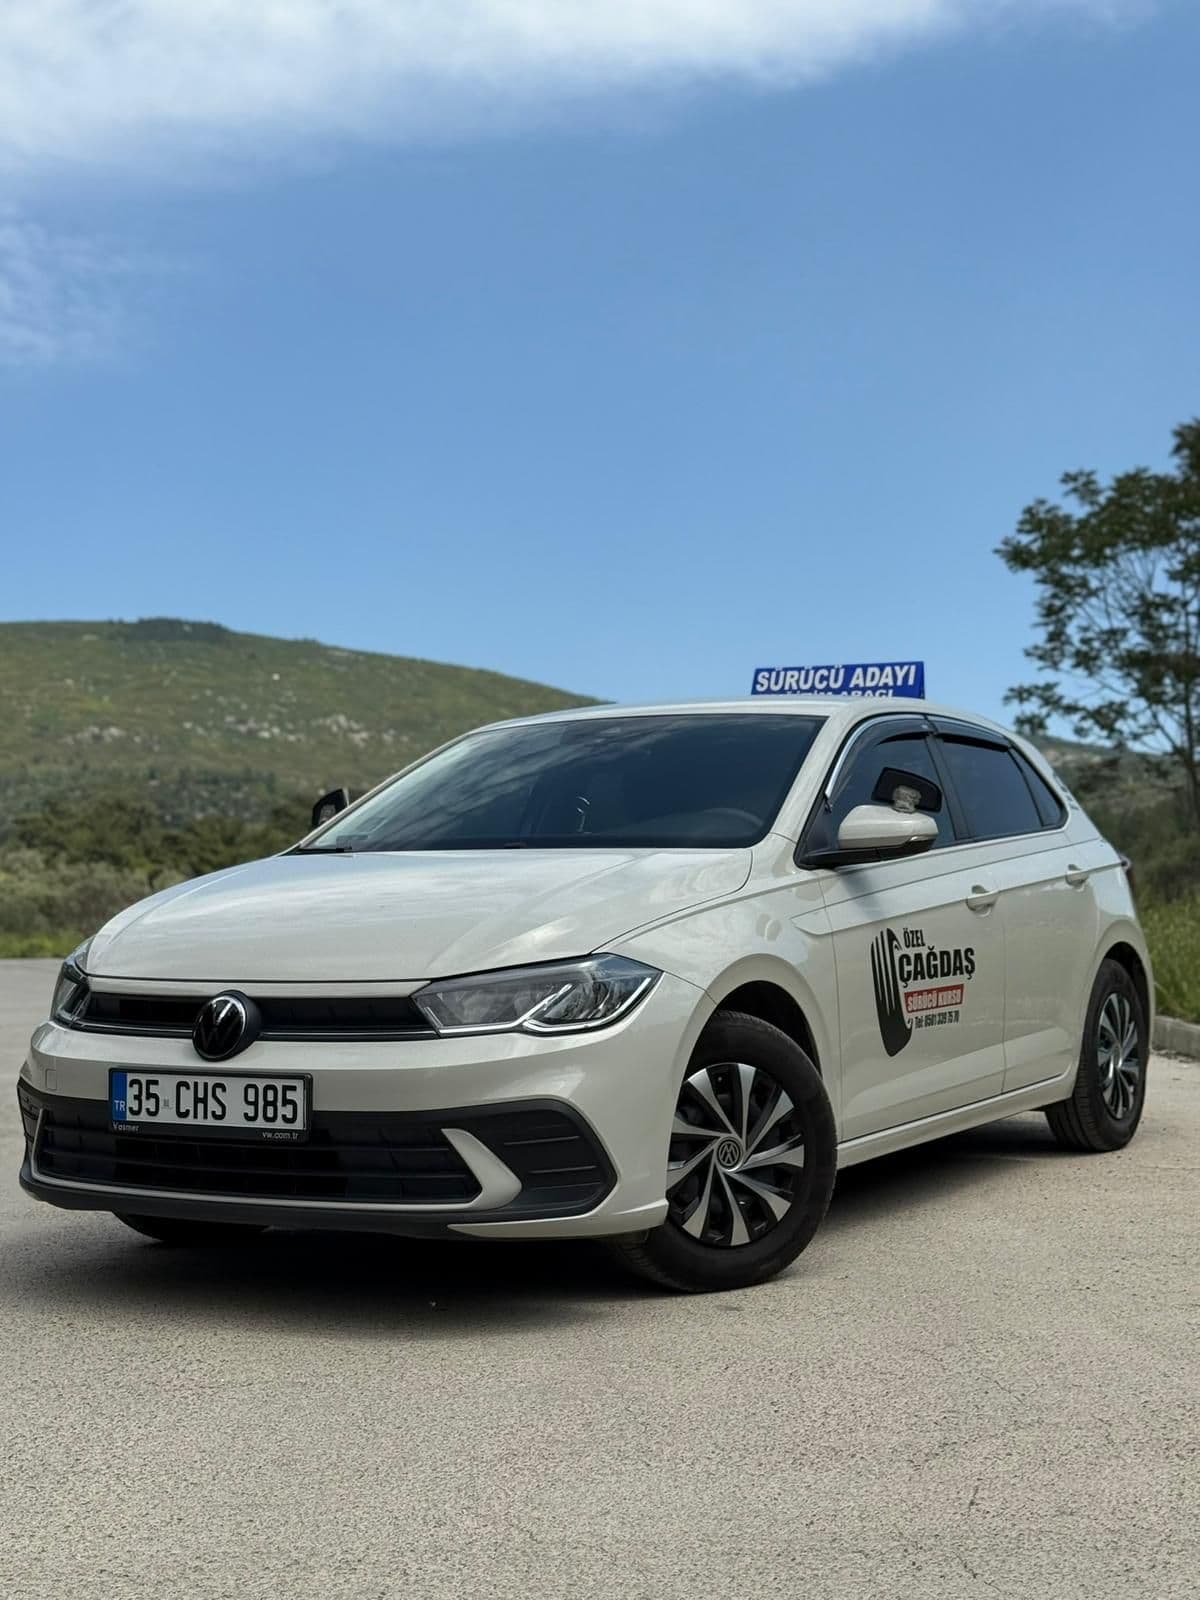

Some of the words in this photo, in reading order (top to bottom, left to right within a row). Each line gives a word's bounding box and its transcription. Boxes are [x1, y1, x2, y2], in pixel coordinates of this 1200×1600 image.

[755, 664, 845, 692] SÜRÜCÜ
[850, 664, 917, 688] ADAYI
[902, 927, 926, 949] ÖZEL
[898, 945, 976, 988] ÇAĞDAŞ
[114, 1099, 127, 1112] TR
[128, 1078, 161, 1117] 35
[175, 1080, 227, 1121] CHS
[243, 1083, 298, 1124] 985
